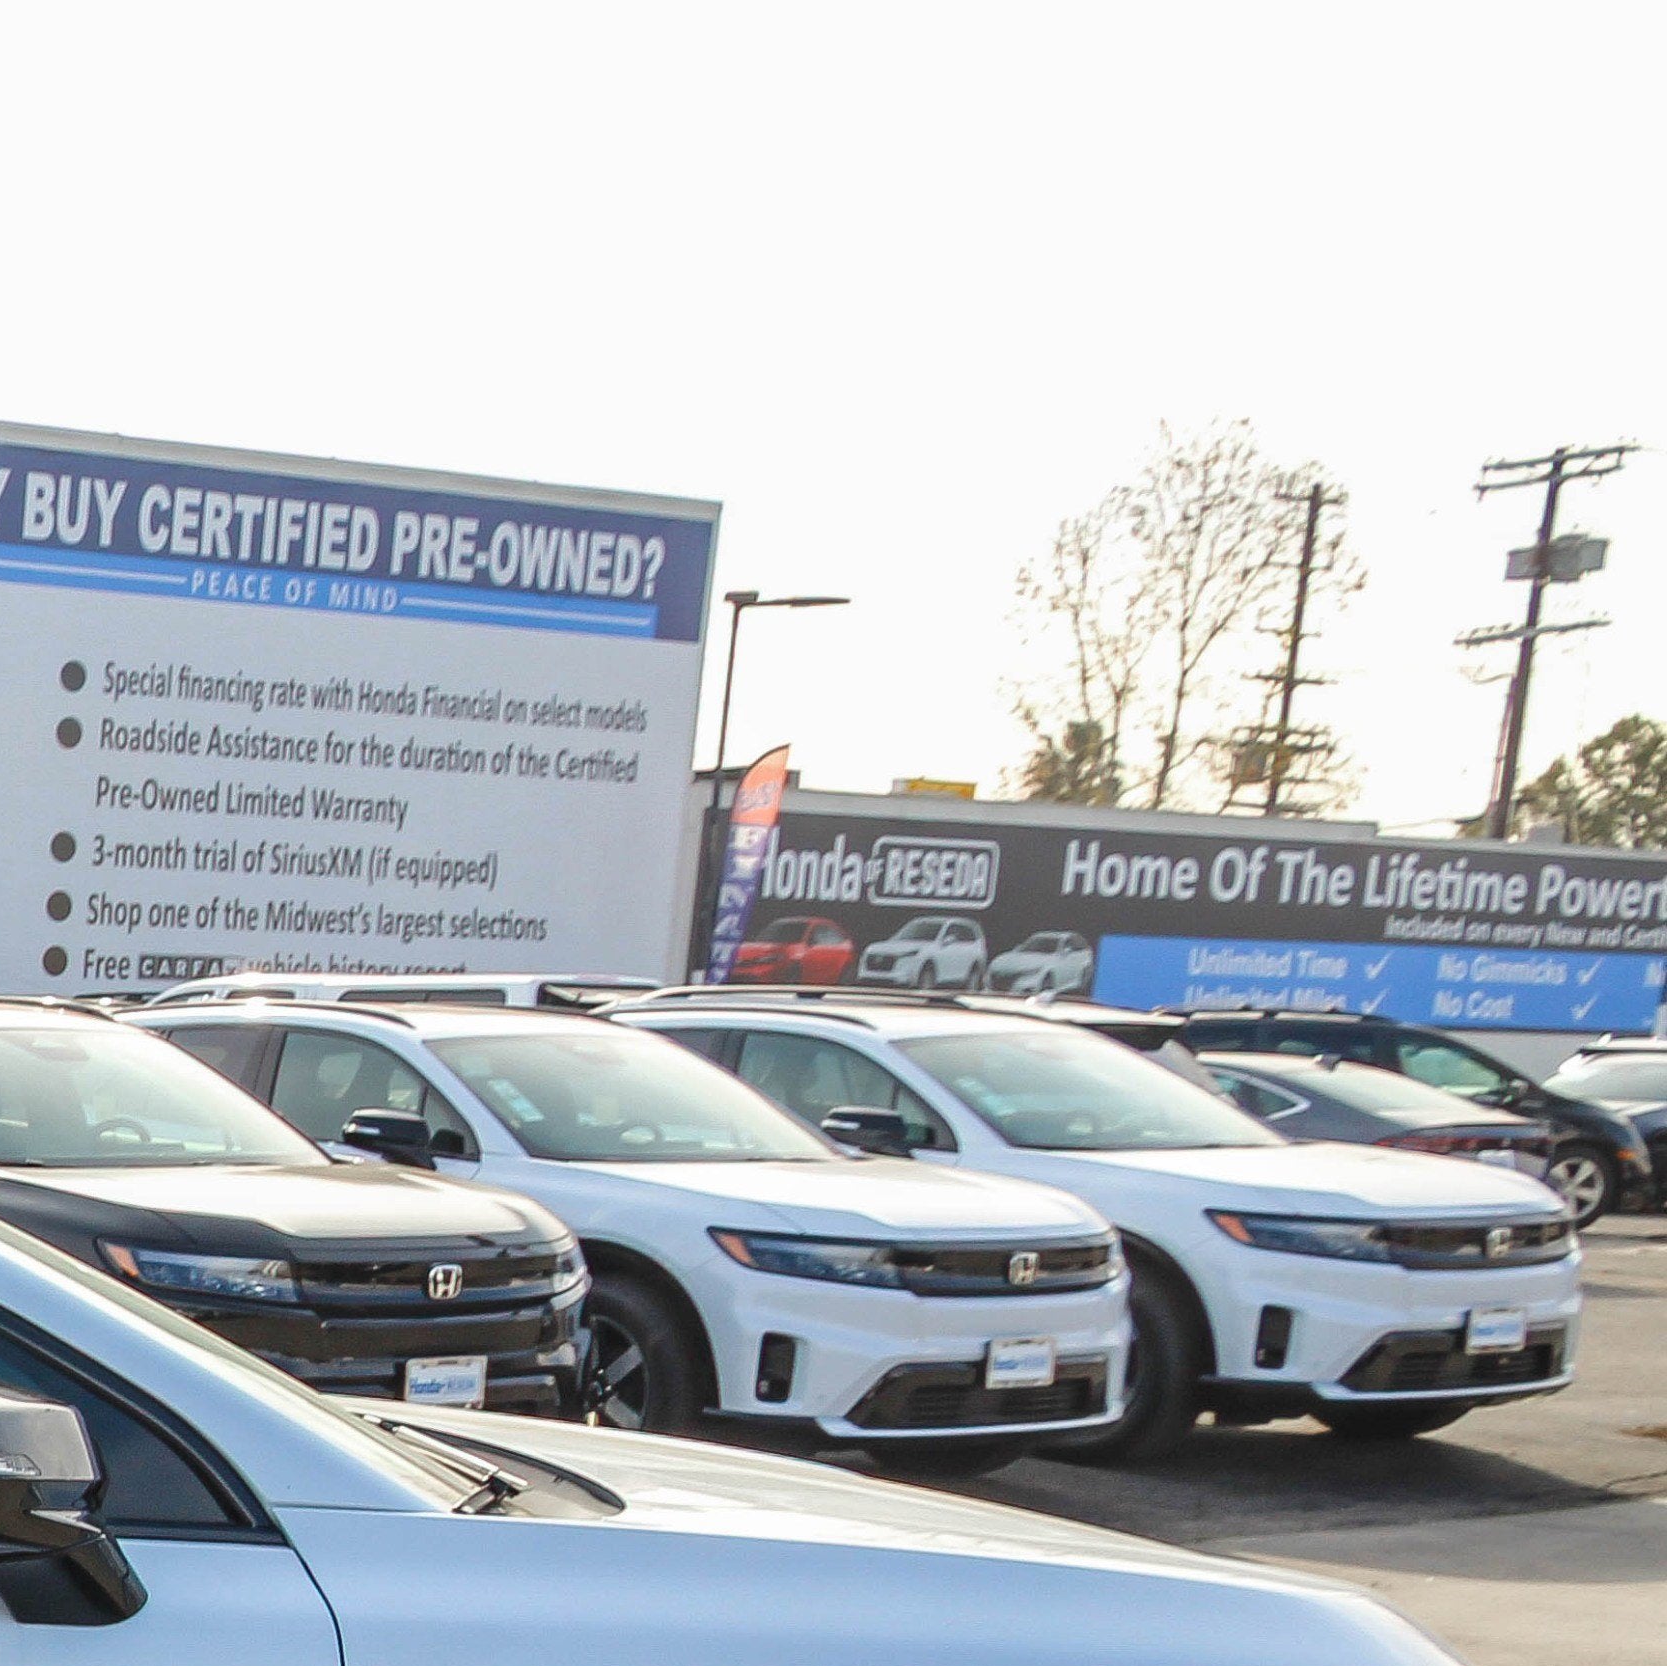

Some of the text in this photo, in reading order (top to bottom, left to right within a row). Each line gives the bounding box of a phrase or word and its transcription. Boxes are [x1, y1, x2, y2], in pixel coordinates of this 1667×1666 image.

[21, 471, 128, 547] BUY
[138, 483, 380, 572] CERTIFIED
[390, 510, 666, 599] PRE-OWNED?
[191, 567, 398, 613] PEACE OF MIND
[102, 660, 174, 703] Special
[177, 663, 267, 713] financing
[268, 678, 307, 709] rate
[310, 676, 354, 712] with
[357, 680, 418, 716] Honda
[419, 684, 502, 722] Financial
[530, 693, 583, 729] select
[99, 716, 640, 785] Roadside Assistance for the duration of the Certified
[95, 774, 409, 833] Pre-Owned Limited Warranty
[92, 834, 499, 892] 3-month trial of SiriusXM (if equipped)
[883, 848, 991, 898] RESEDA
[1061, 838, 1199, 901] Home
[1208, 846, 1269, 903] Of
[1275, 848, 1355, 907] The
[1363, 851, 1528, 915] Lifetime
[86, 891, 549, 945] Shop one of the Midwest's largest selections
[83, 949, 131, 980] Free
[139, 955, 237, 979] CARFA
